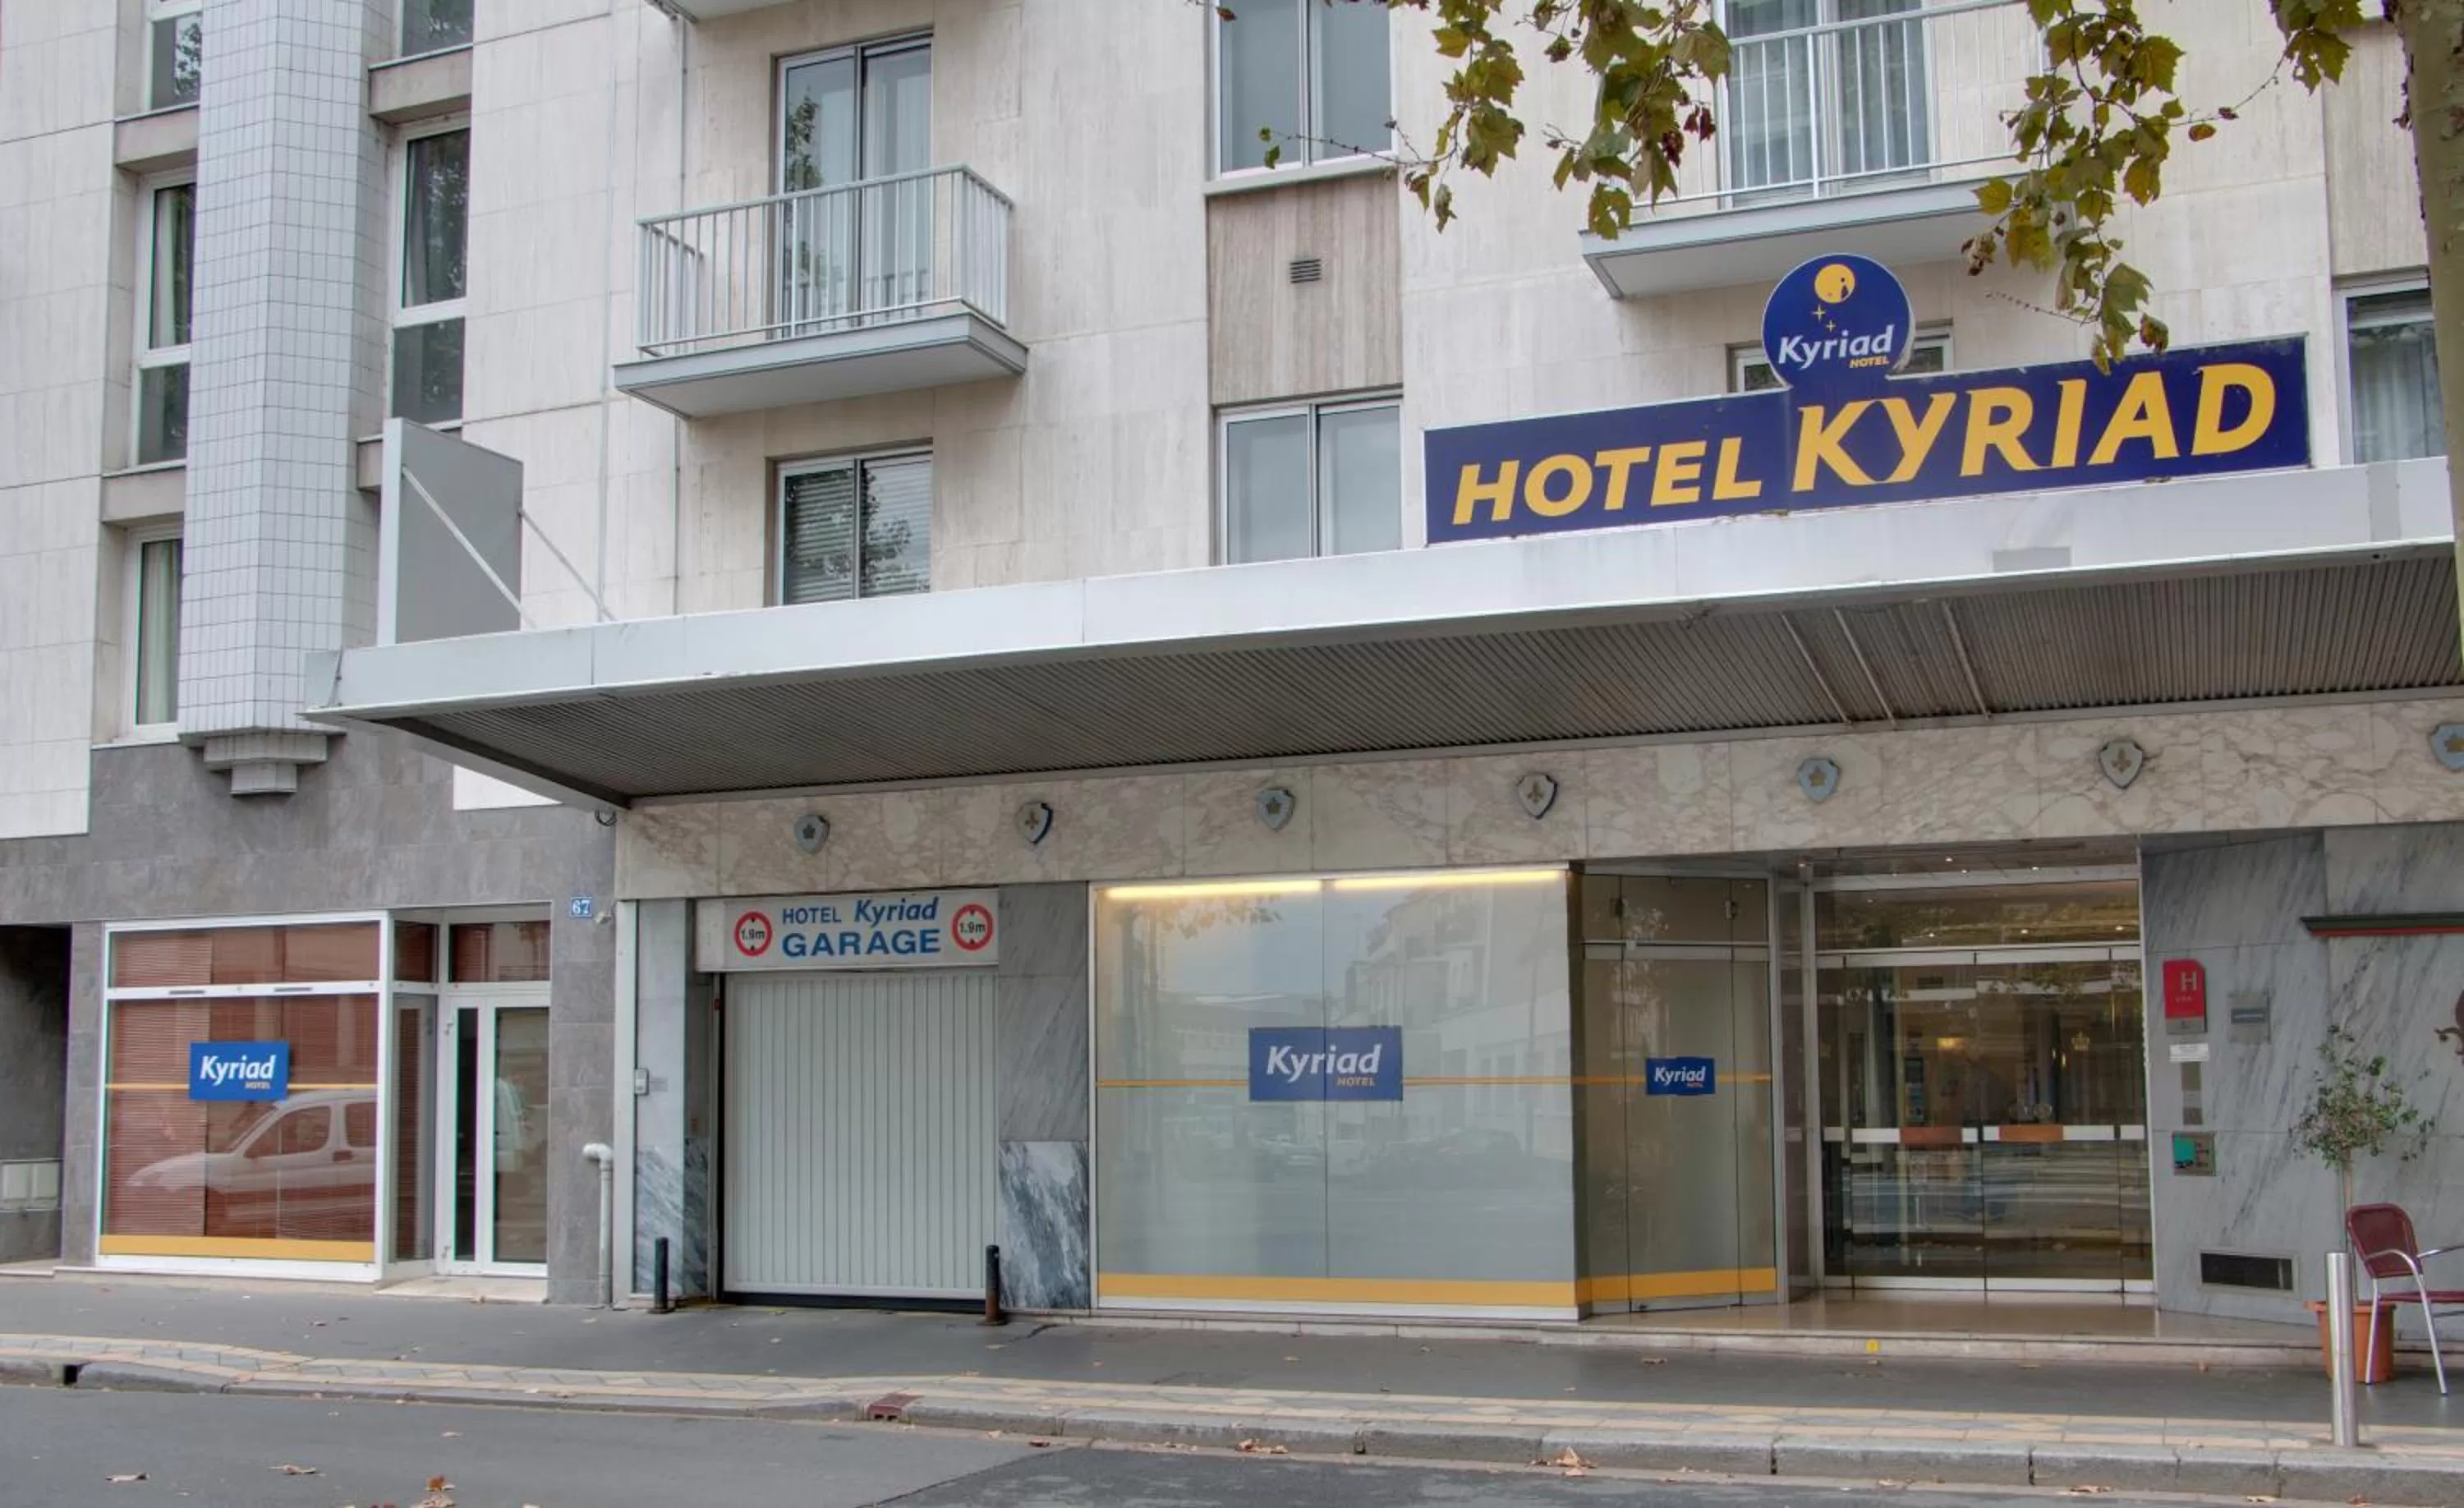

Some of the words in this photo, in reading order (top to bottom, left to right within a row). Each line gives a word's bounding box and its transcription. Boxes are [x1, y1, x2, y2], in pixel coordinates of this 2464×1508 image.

[1778, 324, 1895, 370] Kyriad
[1850, 355, 1889, 368] HOTEL
[1453, 437, 1763, 525] HOTEL
[1791, 362, 2277, 493] KYRIAD
[572, 899, 591, 914] 67
[782, 906, 842, 925] HOTEL
[853, 895, 940, 928] Kyriad
[782, 928, 941, 959] GARAGE
[200, 1054, 277, 1087] Kyriad
[1266, 1042, 1383, 1083] Kyriad
[1654, 1065, 1706, 1087] Kyriad
[1337, 1077, 1376, 1087] HOTEL
